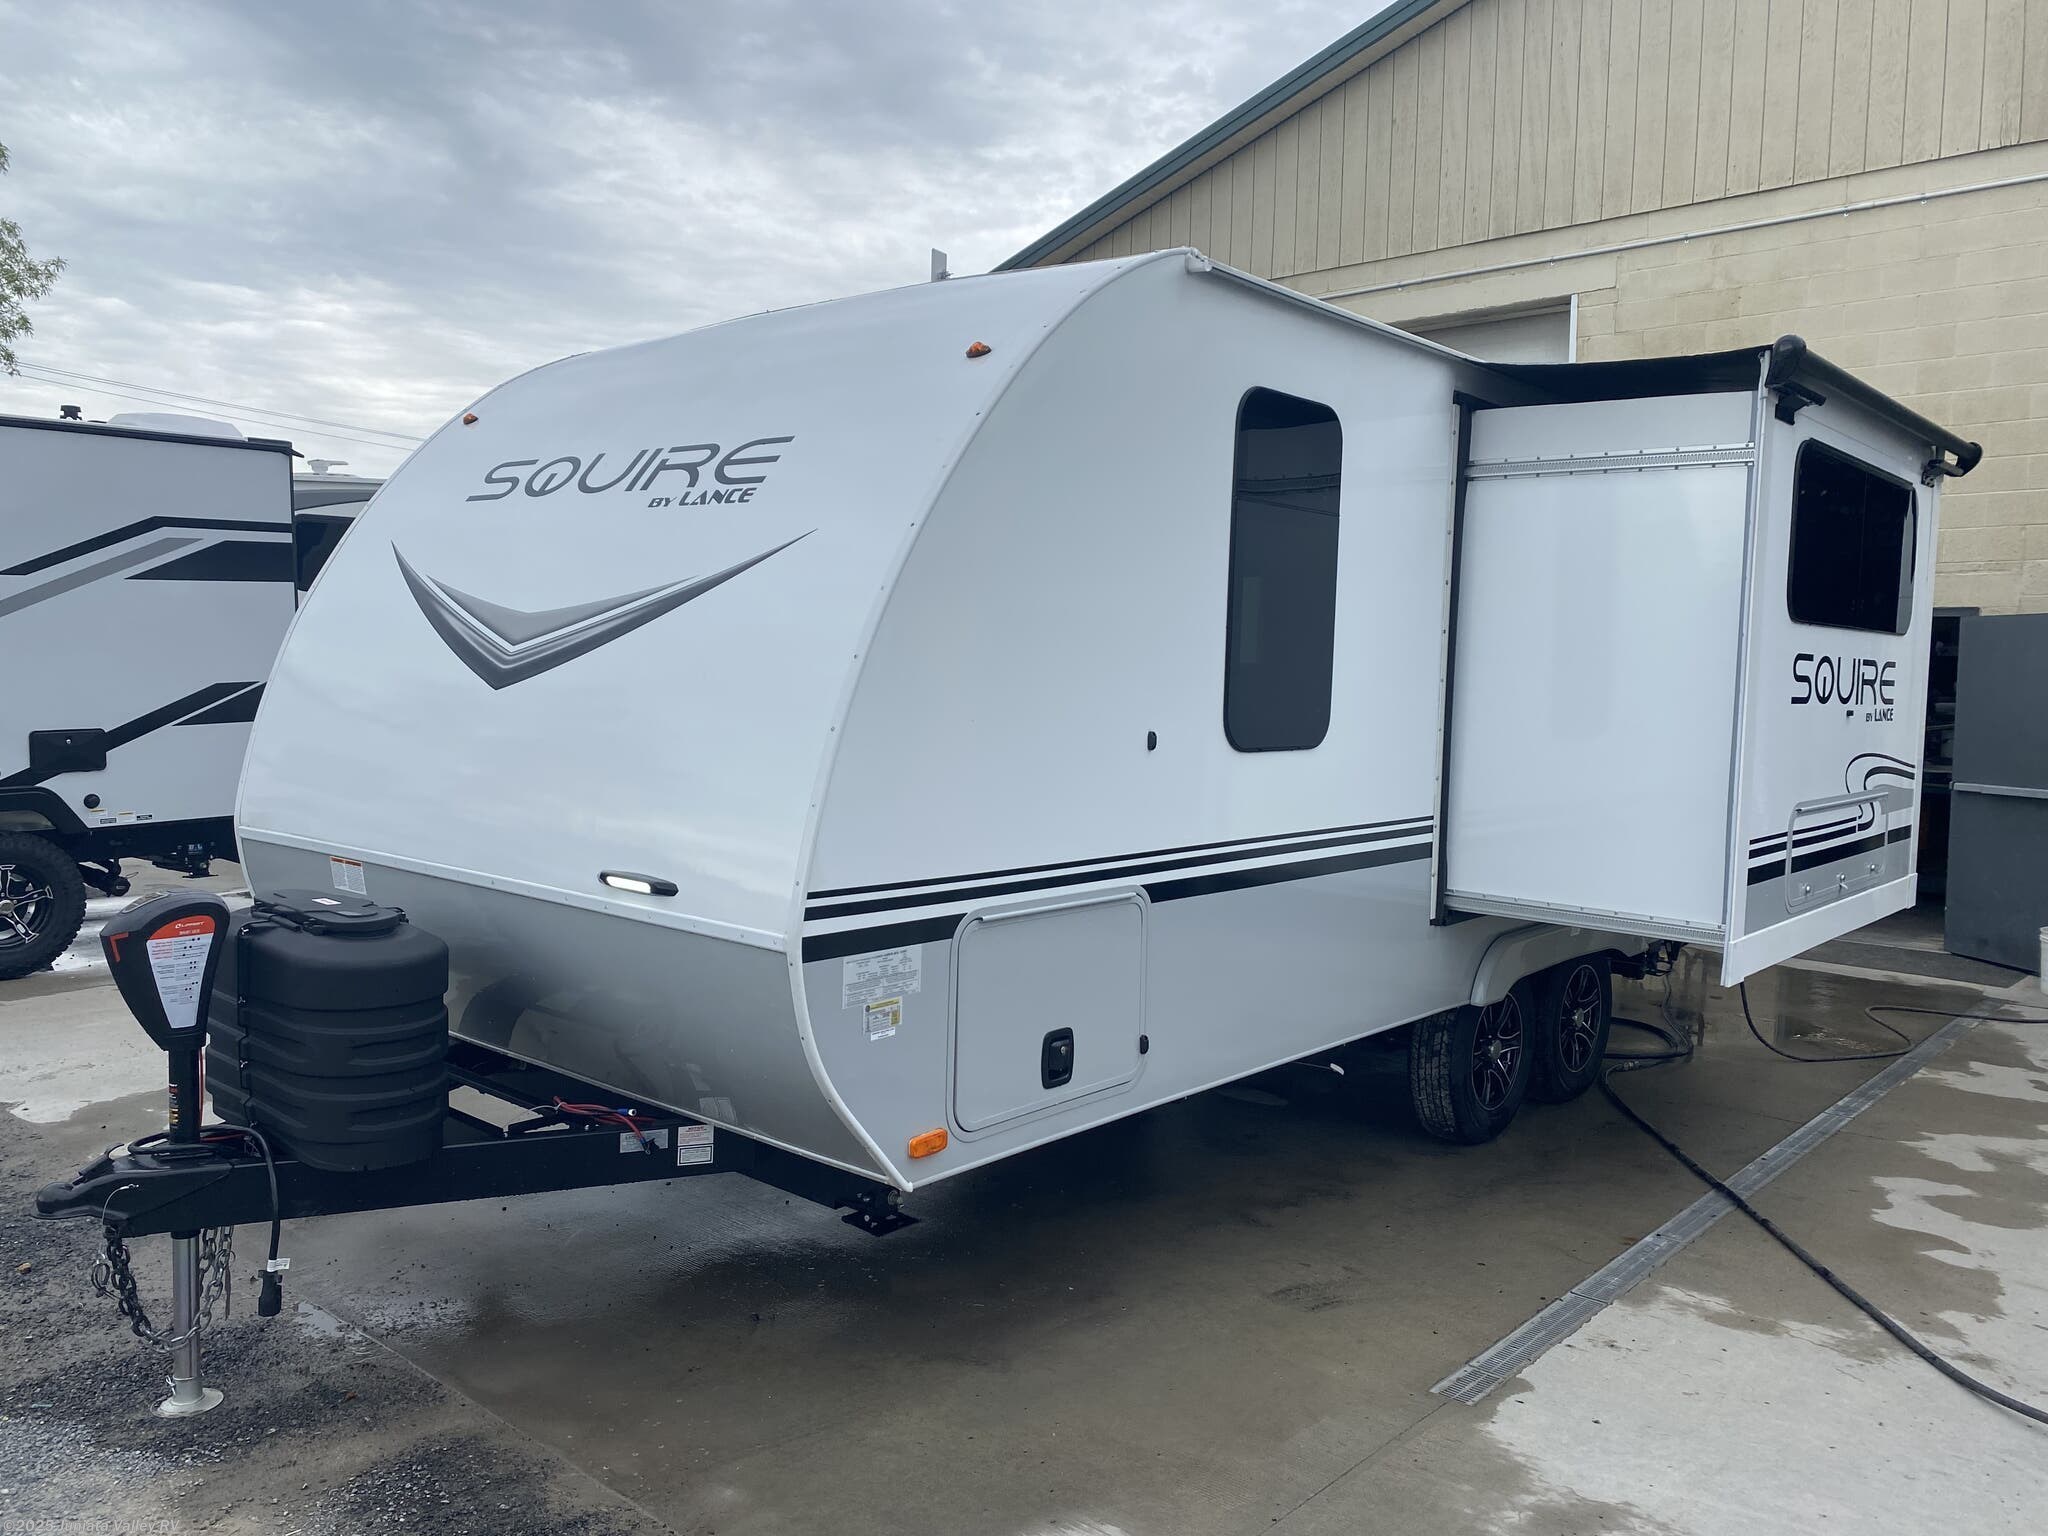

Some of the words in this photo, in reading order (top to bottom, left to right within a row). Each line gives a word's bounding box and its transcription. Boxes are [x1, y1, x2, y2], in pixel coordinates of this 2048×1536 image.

[465, 435, 796, 502] SQUIRE
[648, 496, 678, 509] BY
[678, 487, 758, 507] LANCE
[1791, 653, 1897, 705] SQUIRE
[1865, 712, 1873, 722] BY
[1874, 708, 1894, 722] LANCE
